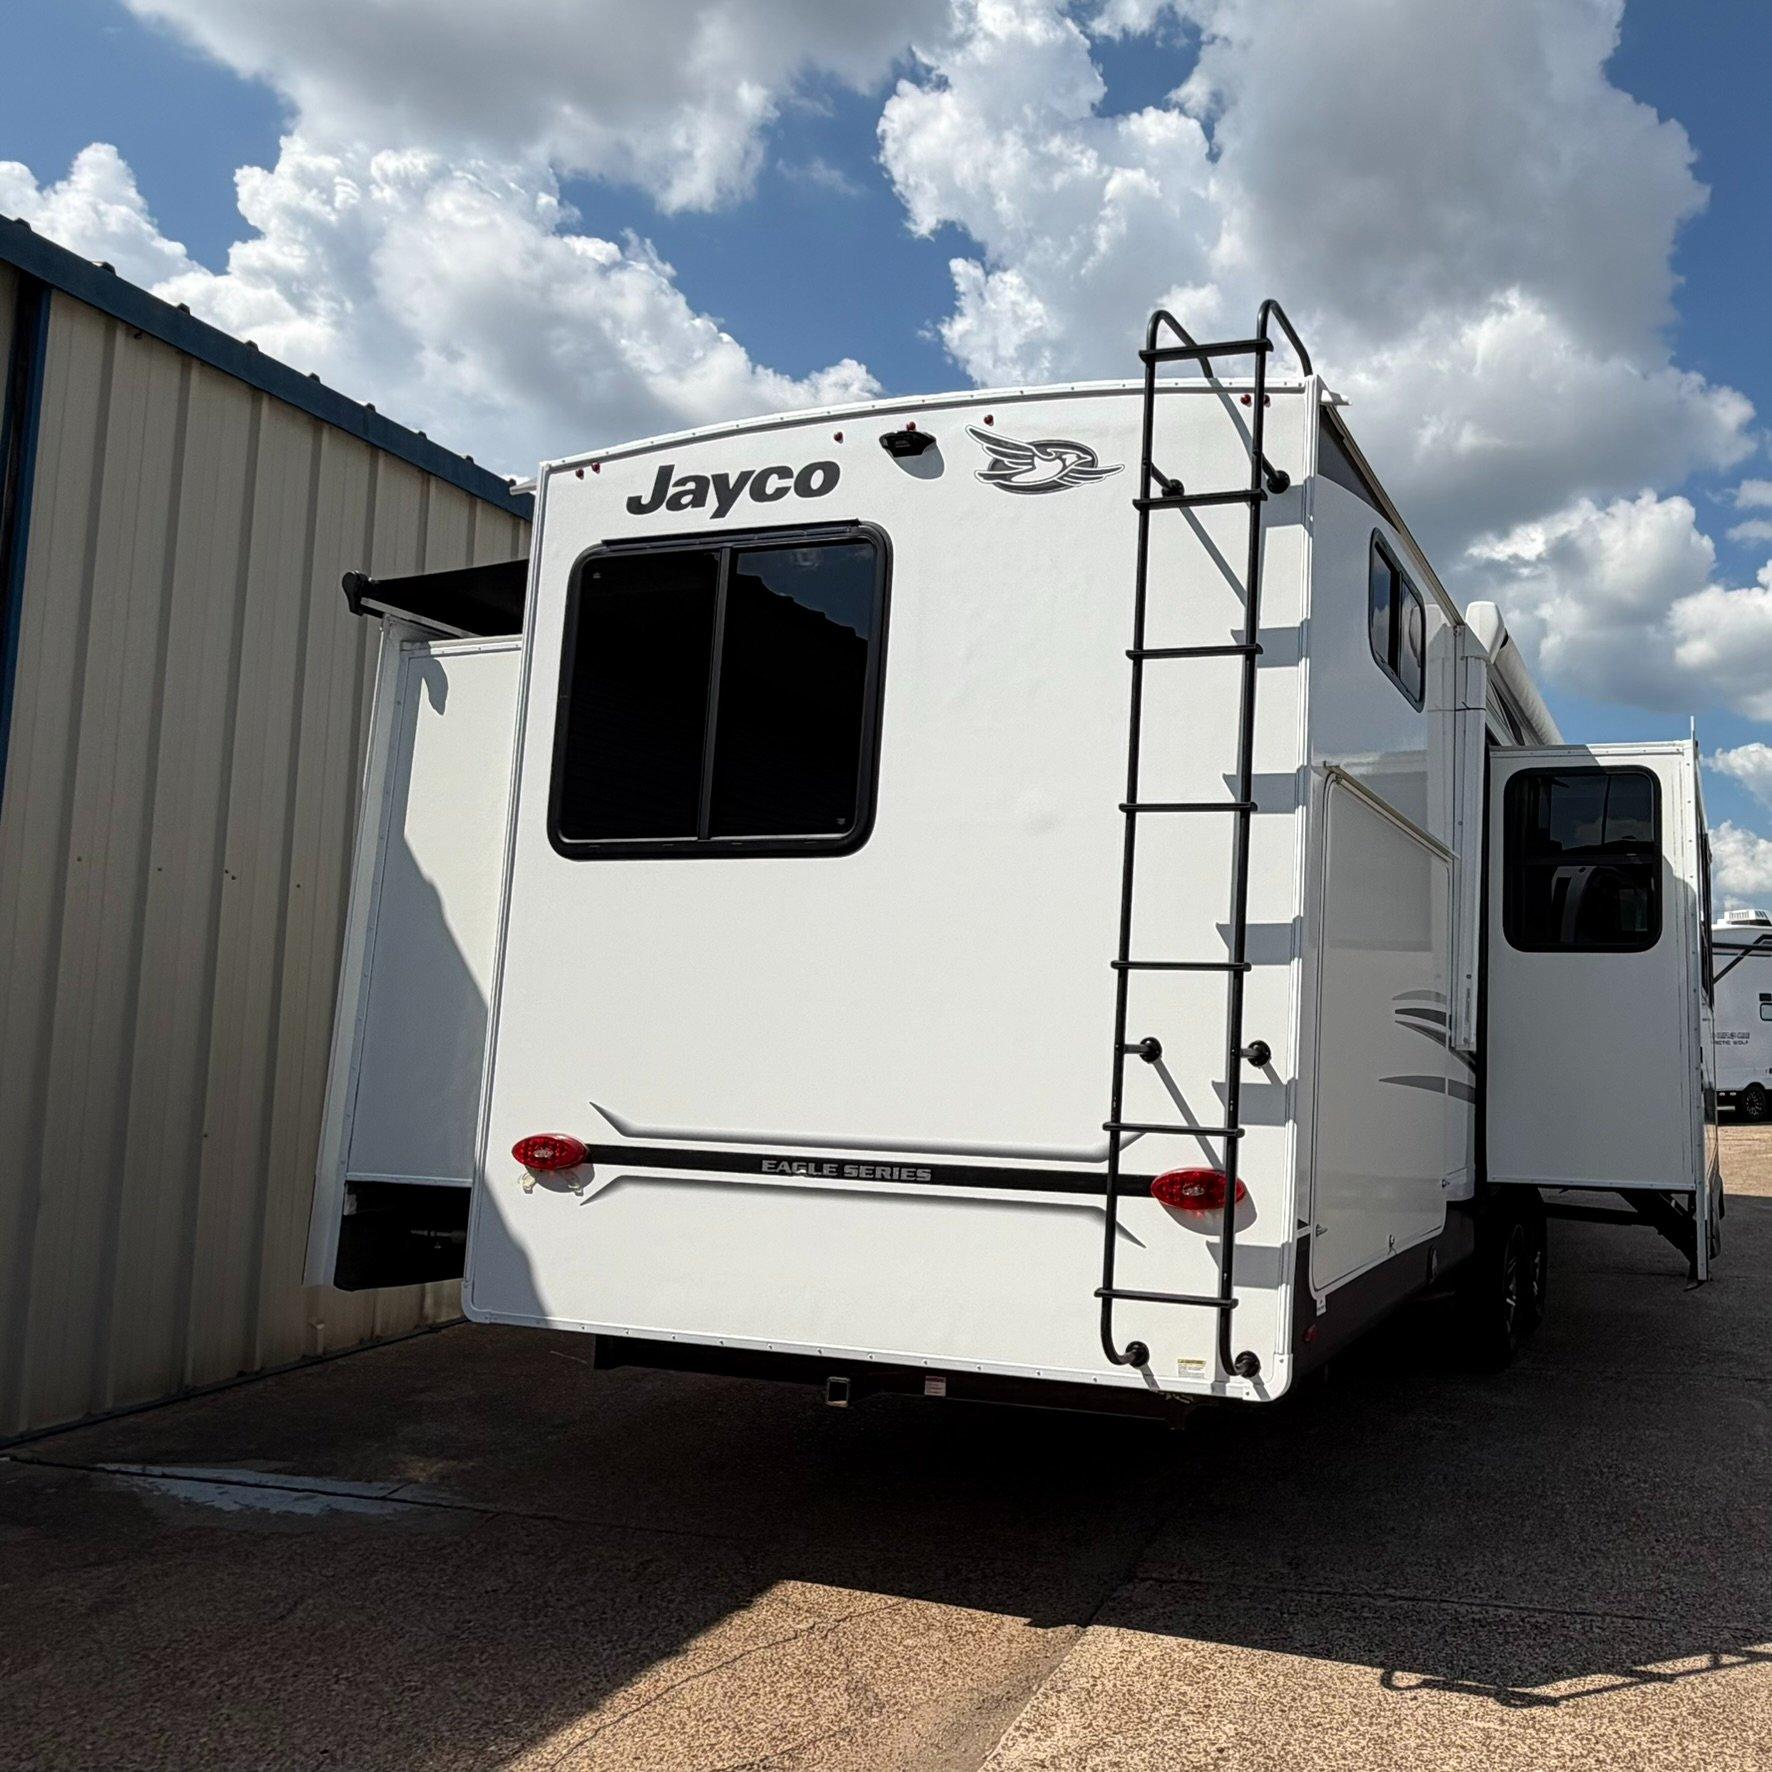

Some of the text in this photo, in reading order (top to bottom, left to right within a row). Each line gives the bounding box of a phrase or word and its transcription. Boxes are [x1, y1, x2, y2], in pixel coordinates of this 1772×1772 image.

[625, 460, 841, 520] Jayco
[761, 1159, 932, 1182] EAGLE SERIES
